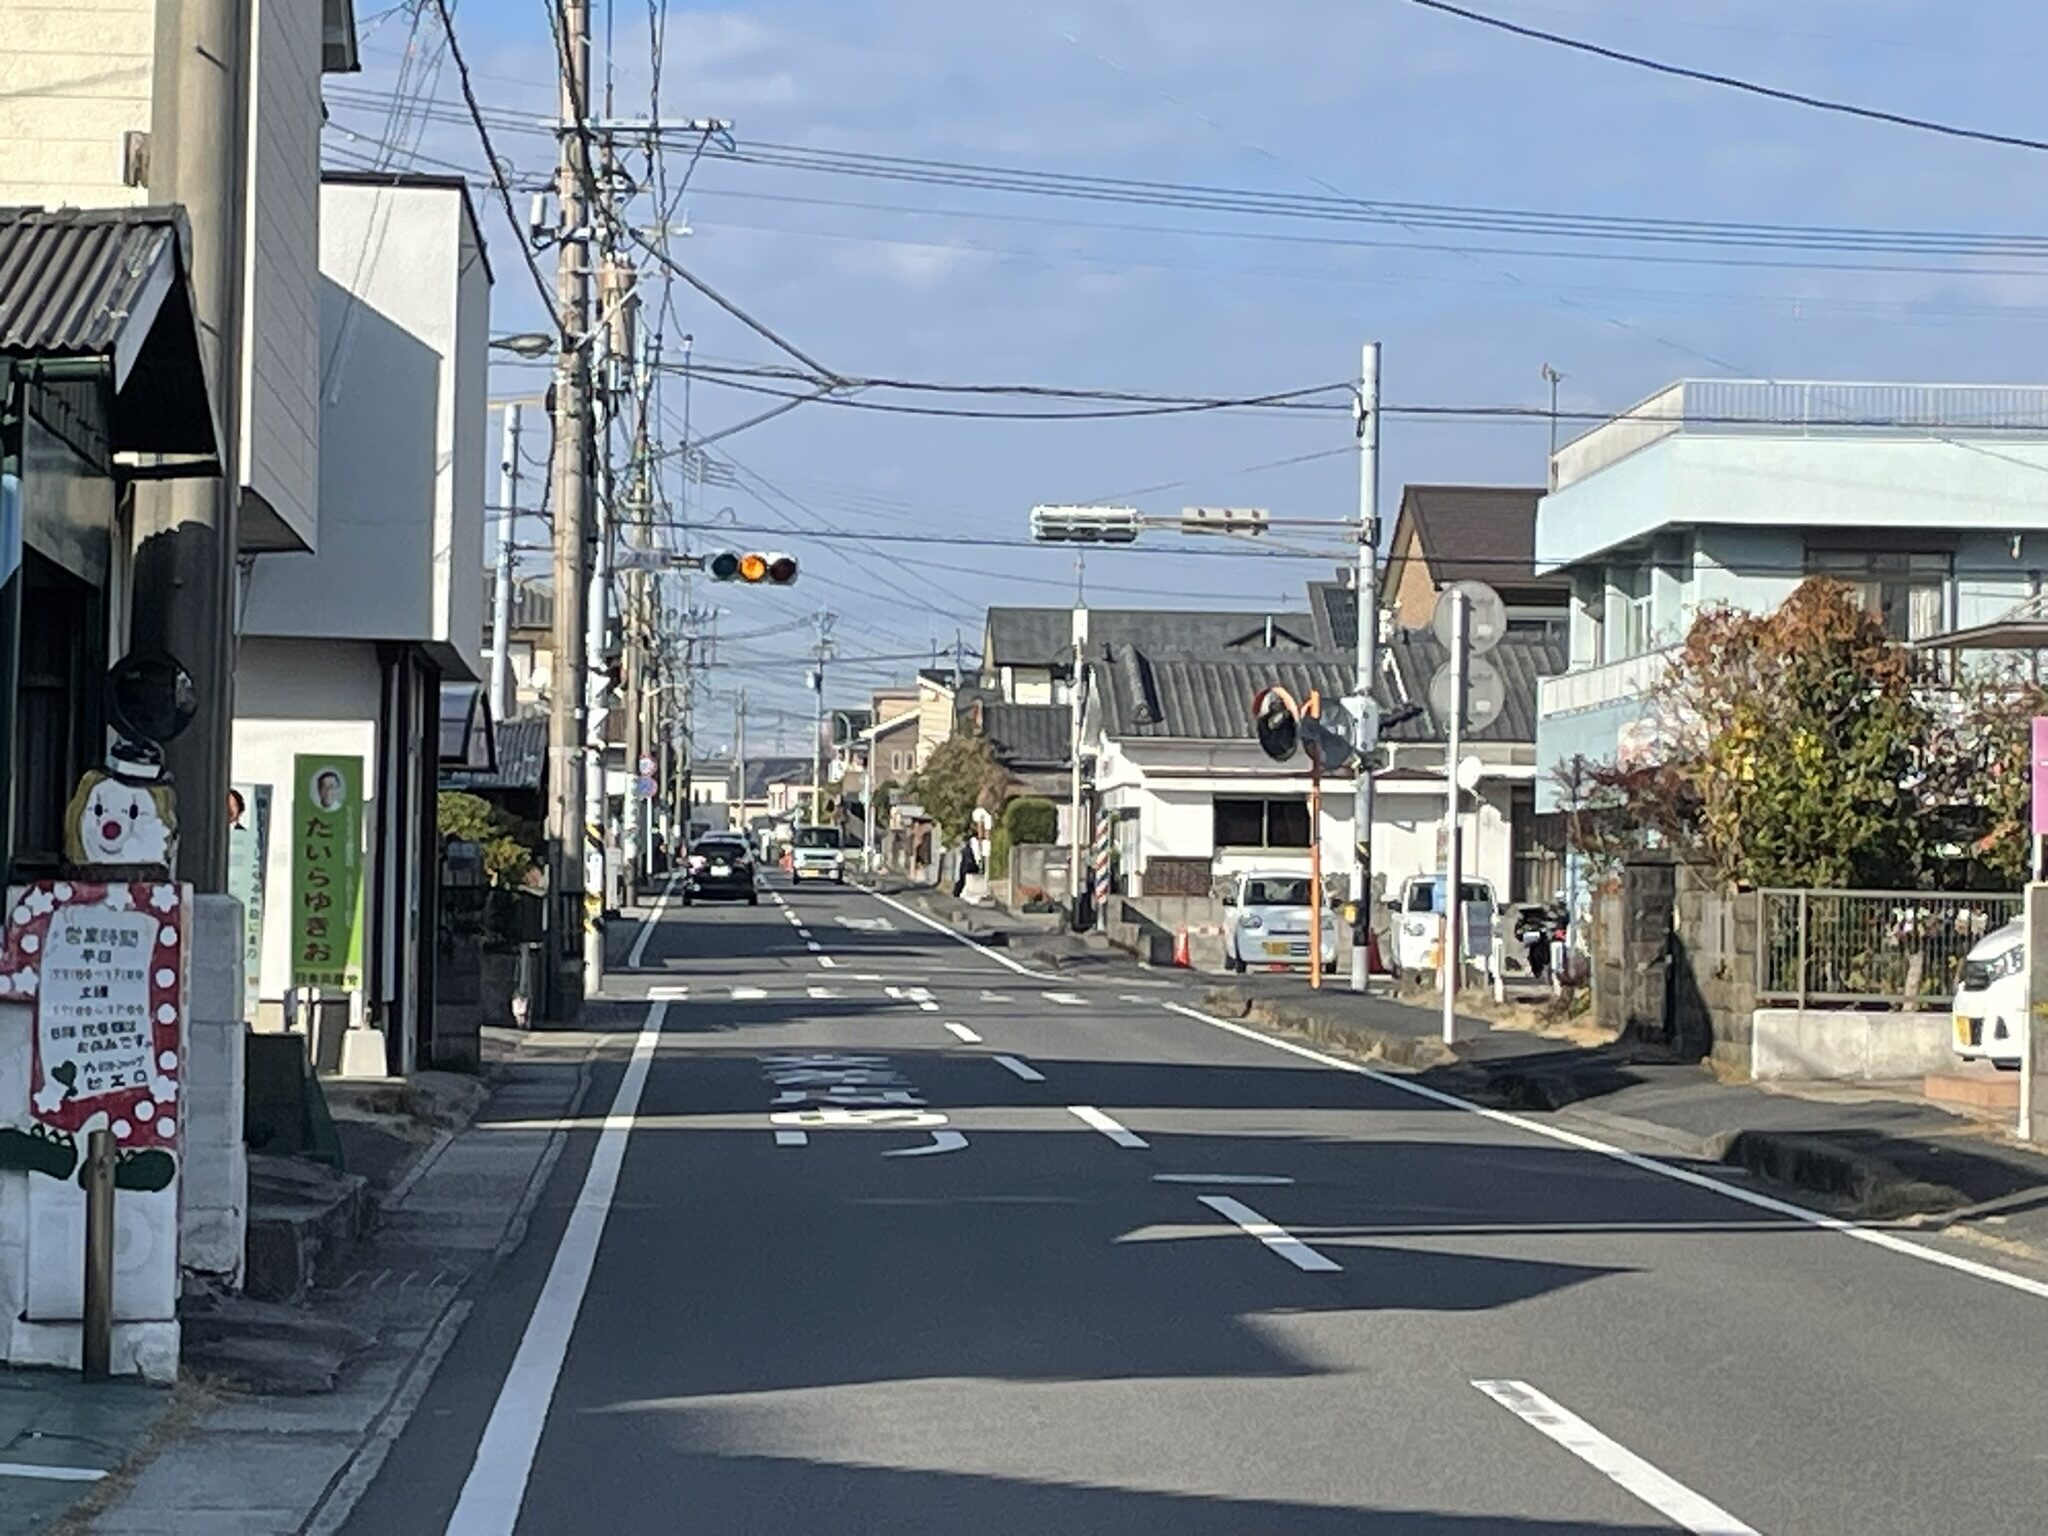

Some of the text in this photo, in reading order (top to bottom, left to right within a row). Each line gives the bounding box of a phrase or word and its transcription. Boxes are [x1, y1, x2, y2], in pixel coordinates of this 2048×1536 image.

[304, 816, 333, 963] たいらゆきお
[65, 926, 139, 948] 営業時間
